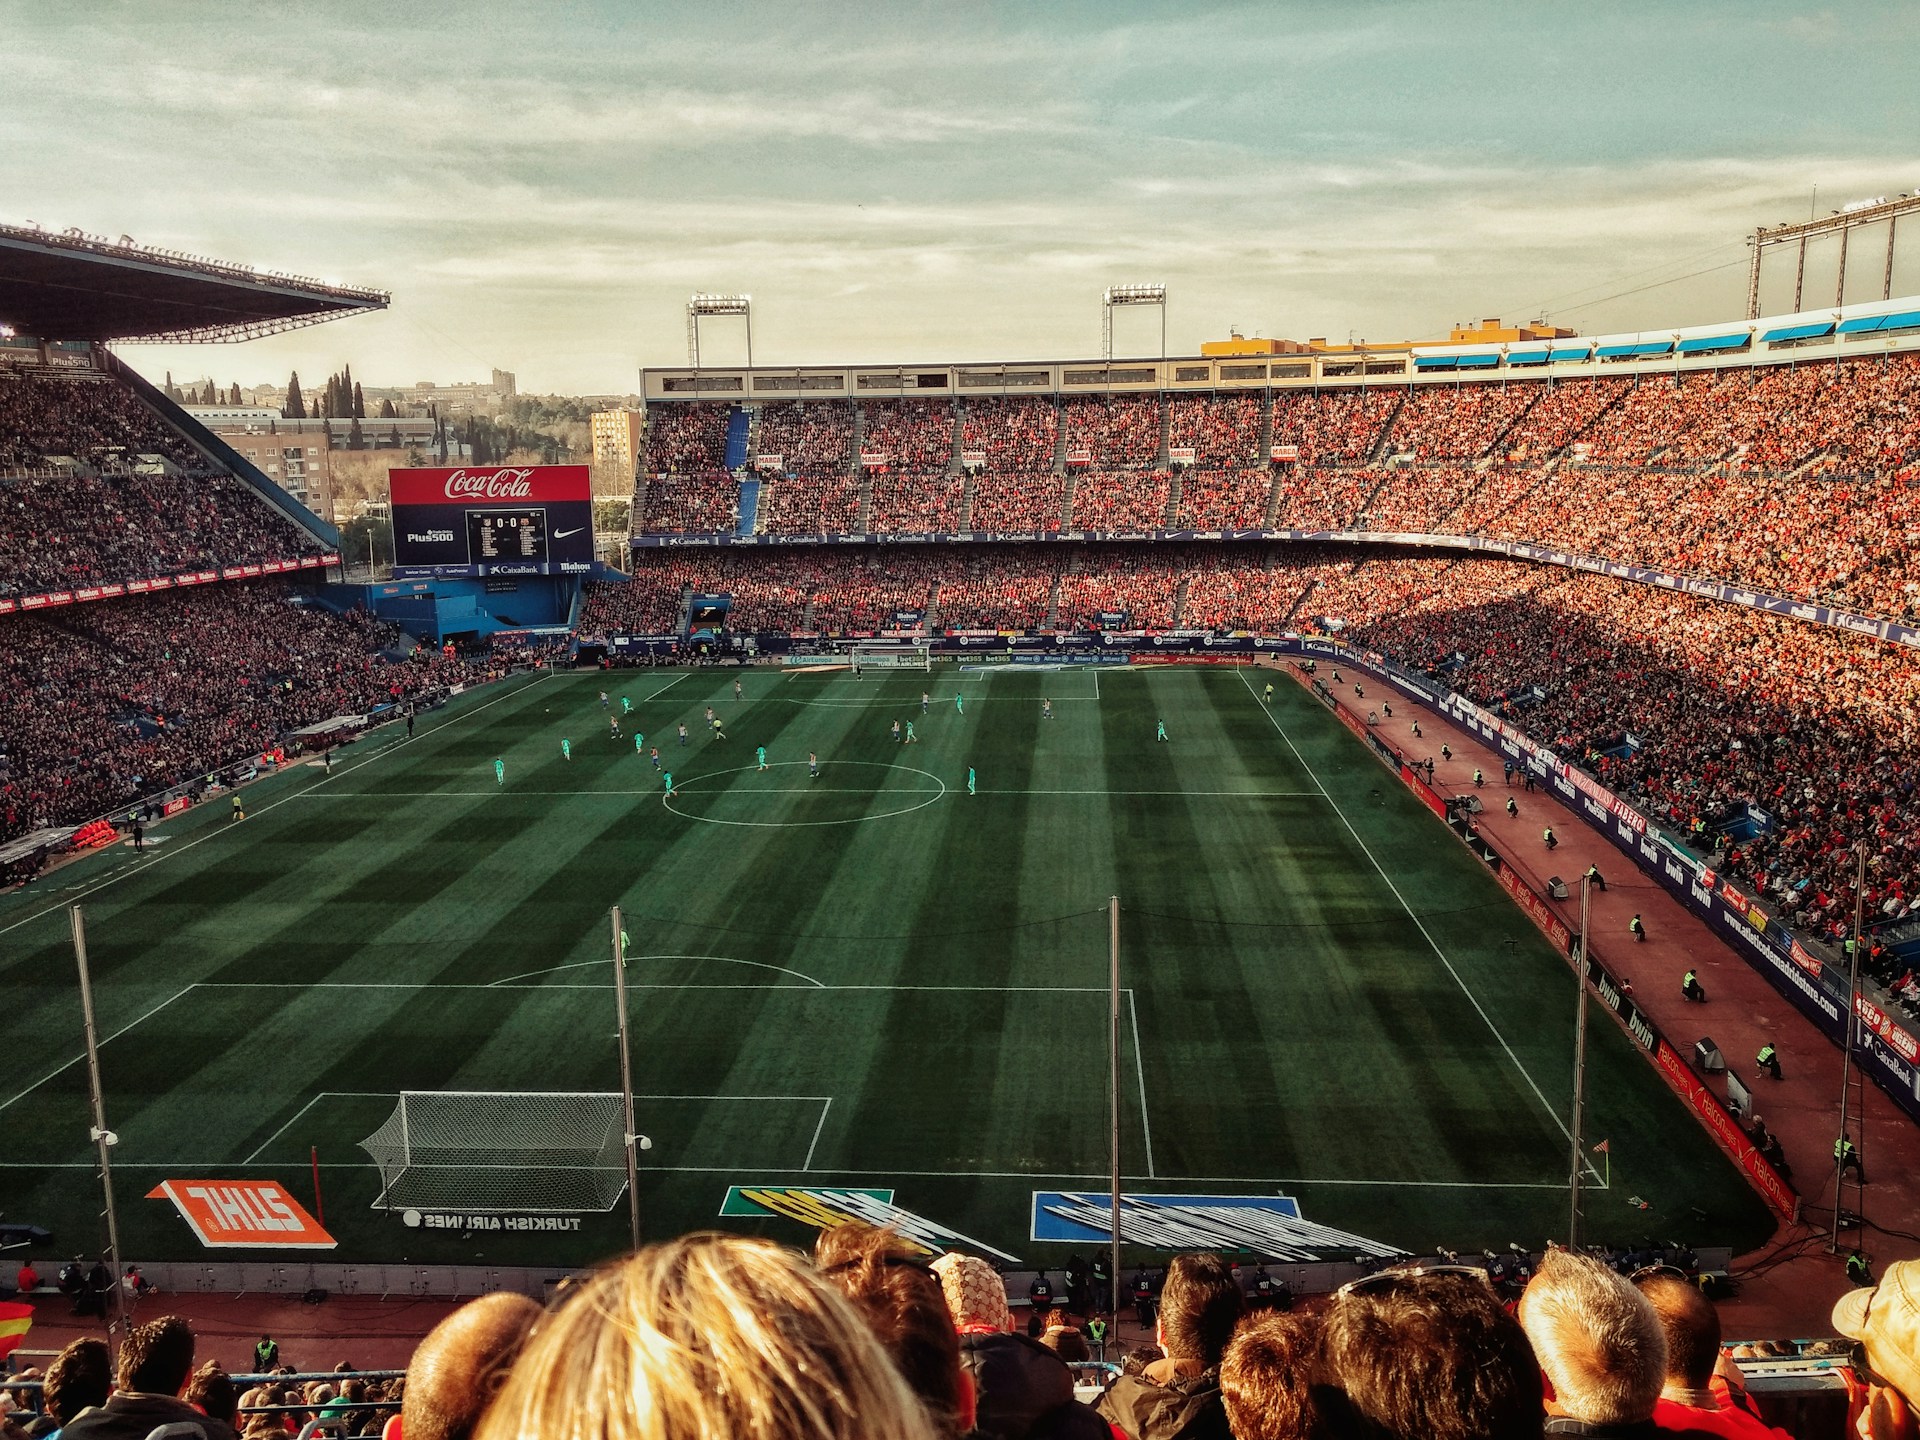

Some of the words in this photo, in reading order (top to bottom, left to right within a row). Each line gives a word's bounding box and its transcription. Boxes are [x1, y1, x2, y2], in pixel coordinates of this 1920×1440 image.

[759, 456, 781, 464] MARCA
[861, 455, 884, 464] MARCA
[962, 453, 985, 462] MARCA
[1067, 451, 1090, 460] MARCA
[1170, 450, 1194, 458] MARCA
[1273, 448, 1296, 456] MARCA
[444, 469, 535, 498] Coca-Cola
[407, 533, 454, 542] Plus500
[679, 537, 709, 545] CaixaBank
[500, 566, 538, 574] CaixaBank
[560, 562, 590, 570] Mahou
[1614, 802, 1643, 833] FABERO
[1618, 820, 1634, 844] bwin
[1640, 838, 1657, 864] bwin
[1666, 857, 1683, 885] bwin
[1691, 879, 1711, 908] bwin
[1724, 910, 1838, 1020] www.atleticodemadridstore.com
[1599, 973, 1620, 1010] bwin
[1628, 1009, 1653, 1050] bwin
[1874, 1041, 1911, 1088] CaixaBank
